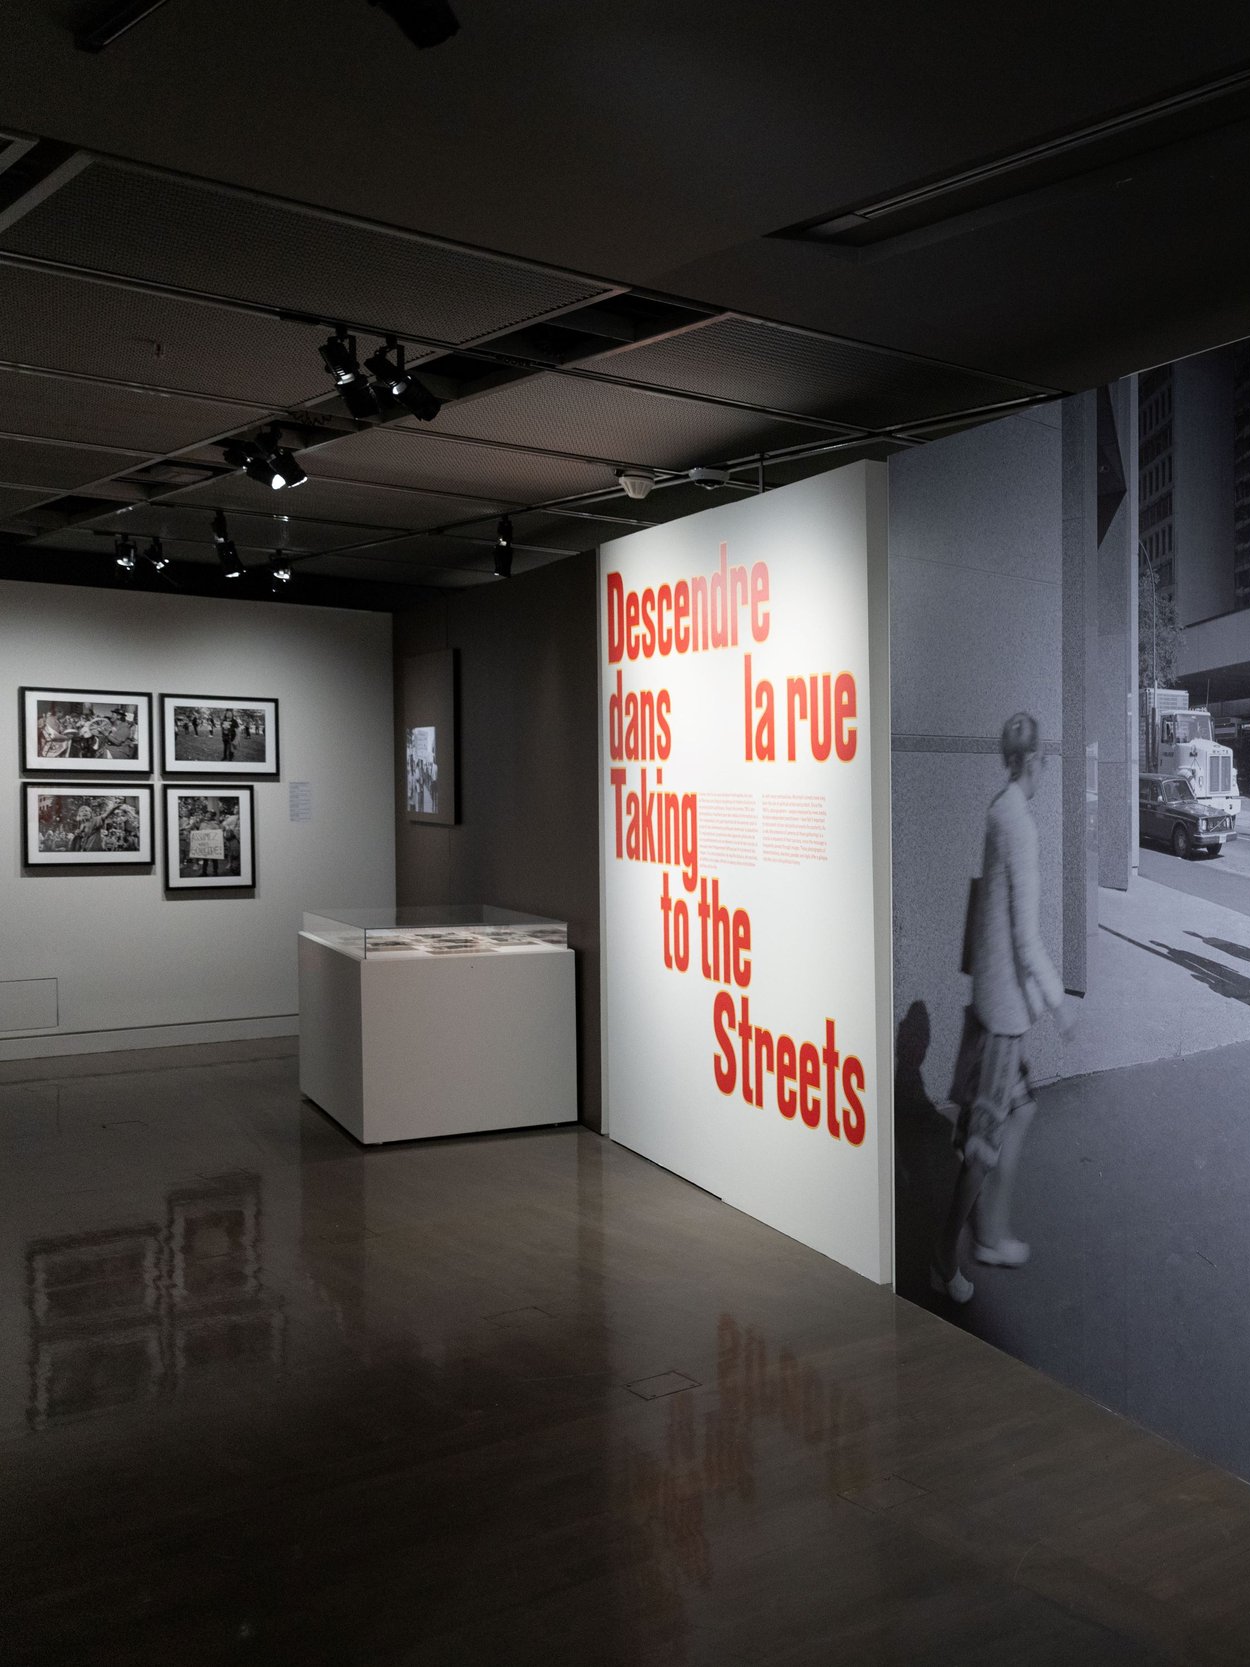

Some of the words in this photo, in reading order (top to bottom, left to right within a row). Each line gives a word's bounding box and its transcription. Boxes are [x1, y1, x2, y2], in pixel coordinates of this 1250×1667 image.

[607, 542, 769, 663] Descendre
[610, 669, 672, 761] dans
[744, 653, 775, 762] la
[787, 671, 858, 762] rue
[610, 767, 698, 893] Taking
[660, 872, 689, 973] to
[698, 876, 751, 988] the
[713, 990, 865, 1146] Streets
